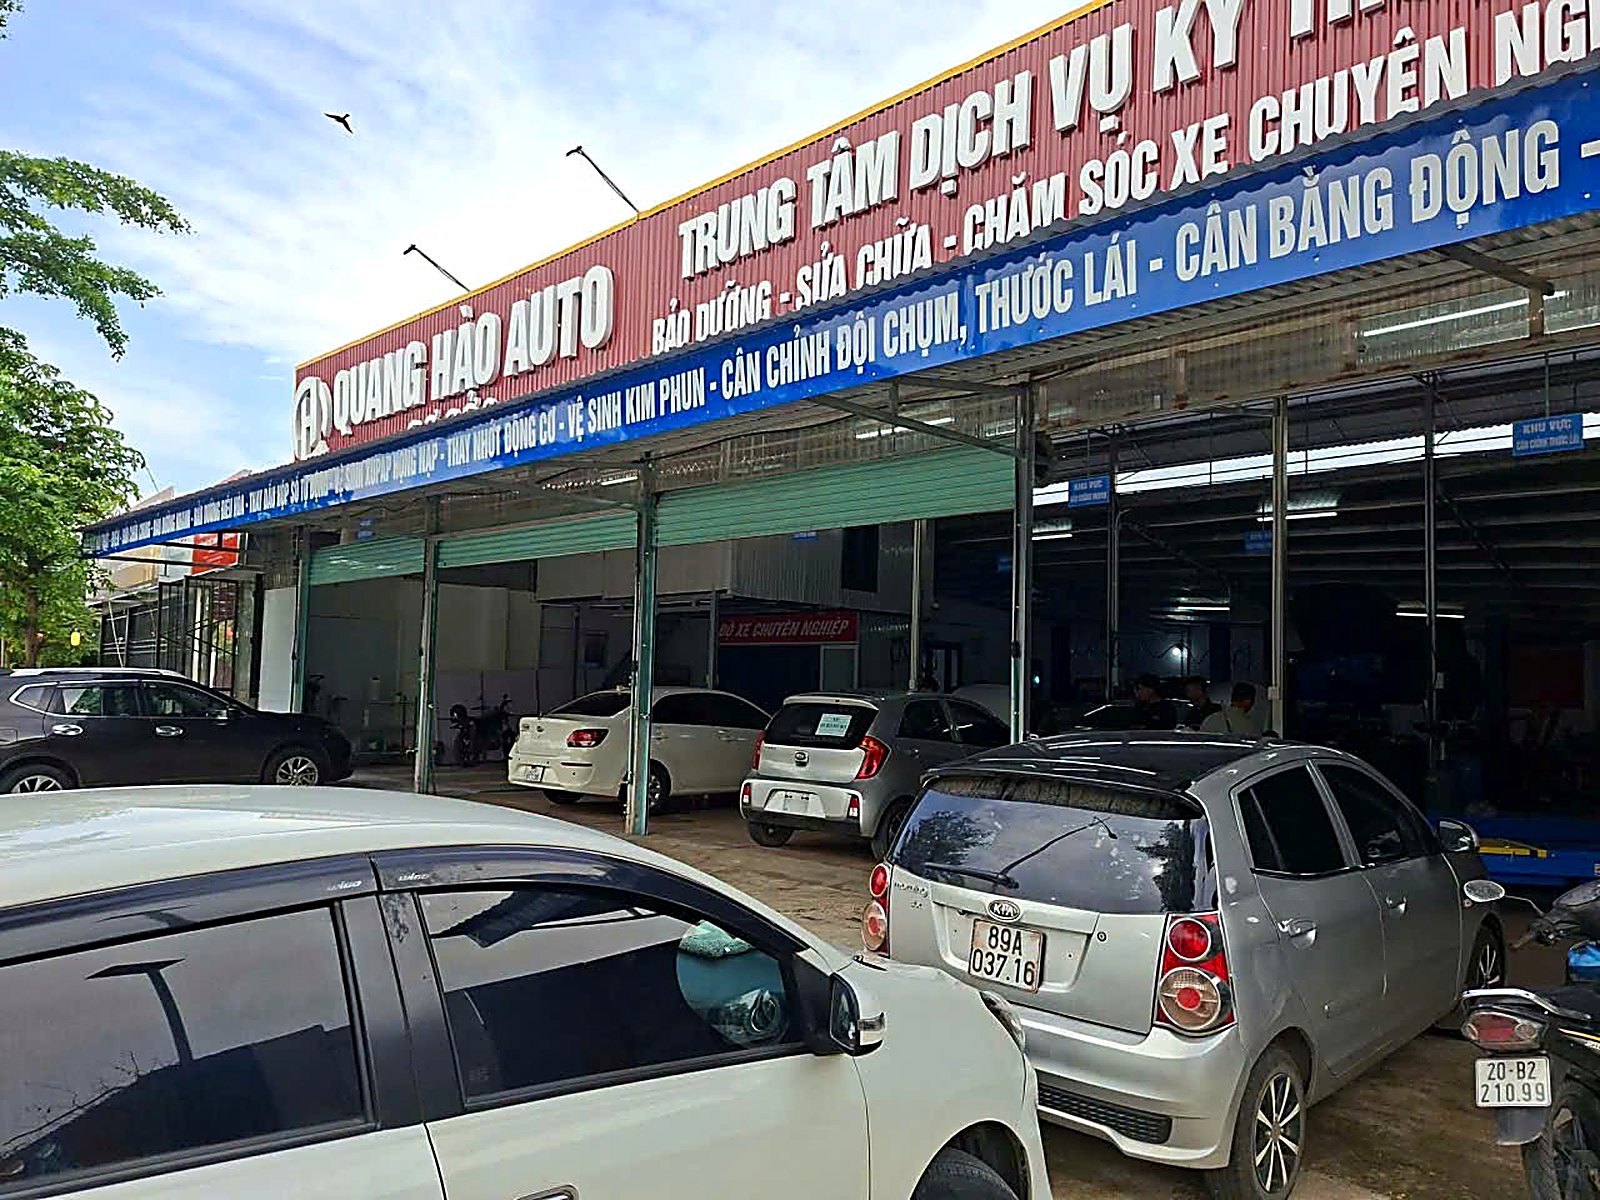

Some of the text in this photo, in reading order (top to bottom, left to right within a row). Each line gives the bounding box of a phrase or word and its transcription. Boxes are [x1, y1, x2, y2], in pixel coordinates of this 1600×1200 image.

[652, 298, 690, 356] BẢO
[697, 280, 771, 341] DƯỠNG
[796, 240, 847, 310] SỬA
[856, 217, 932, 289] CHỮA
[963, 172, 1067, 256] CHĂM
[1079, 131, 1158, 215] SÓC
[1170, 113, 1229, 189] XE
[1249, 26, 1468, 162] CHUYÊN
[1495, 0, 1600, 86] NG
[679, 177, 796, 279] TRUNG
[807, 130, 900, 229] TÂM
[910, 70, 1031, 197] DỊCH
[1050, 23, 1133, 134] VỤ
[447, 432, 472, 467] THAY
[504, 414, 536, 457] ĐỘNG
[539, 406, 556, 444] CƠ
[567, 395, 584, 442] VỆ
[588, 398, 621, 433] SINH
[626, 381, 655, 424] KIM
[660, 366, 705, 416] PHUN
[721, 347, 760, 400] CÂN
[766, 325, 830, 388] CHỈNH
[837, 312, 875, 374] ĐỘI
[883, 291, 966, 358] CHỤM,
[975, 250, 1073, 333] THƯỚC
[1084, 230, 1137, 302] LÁI
[1176, 203, 1258, 282] CÂN
[1269, 163, 1393, 253] BẰNG
[1410, 119, 1560, 229] ĐỘNG
[334, 341, 427, 436] QUANG
[431, 305, 502, 401] HÀO
[503, 265, 614, 377] AUTO
[988, 925, 1022, 956] 89A
[993, 903, 1015, 917] KIA
[972, 949, 1036, 986] 037.16
[1480, 1082, 1546, 1103] 210.99
